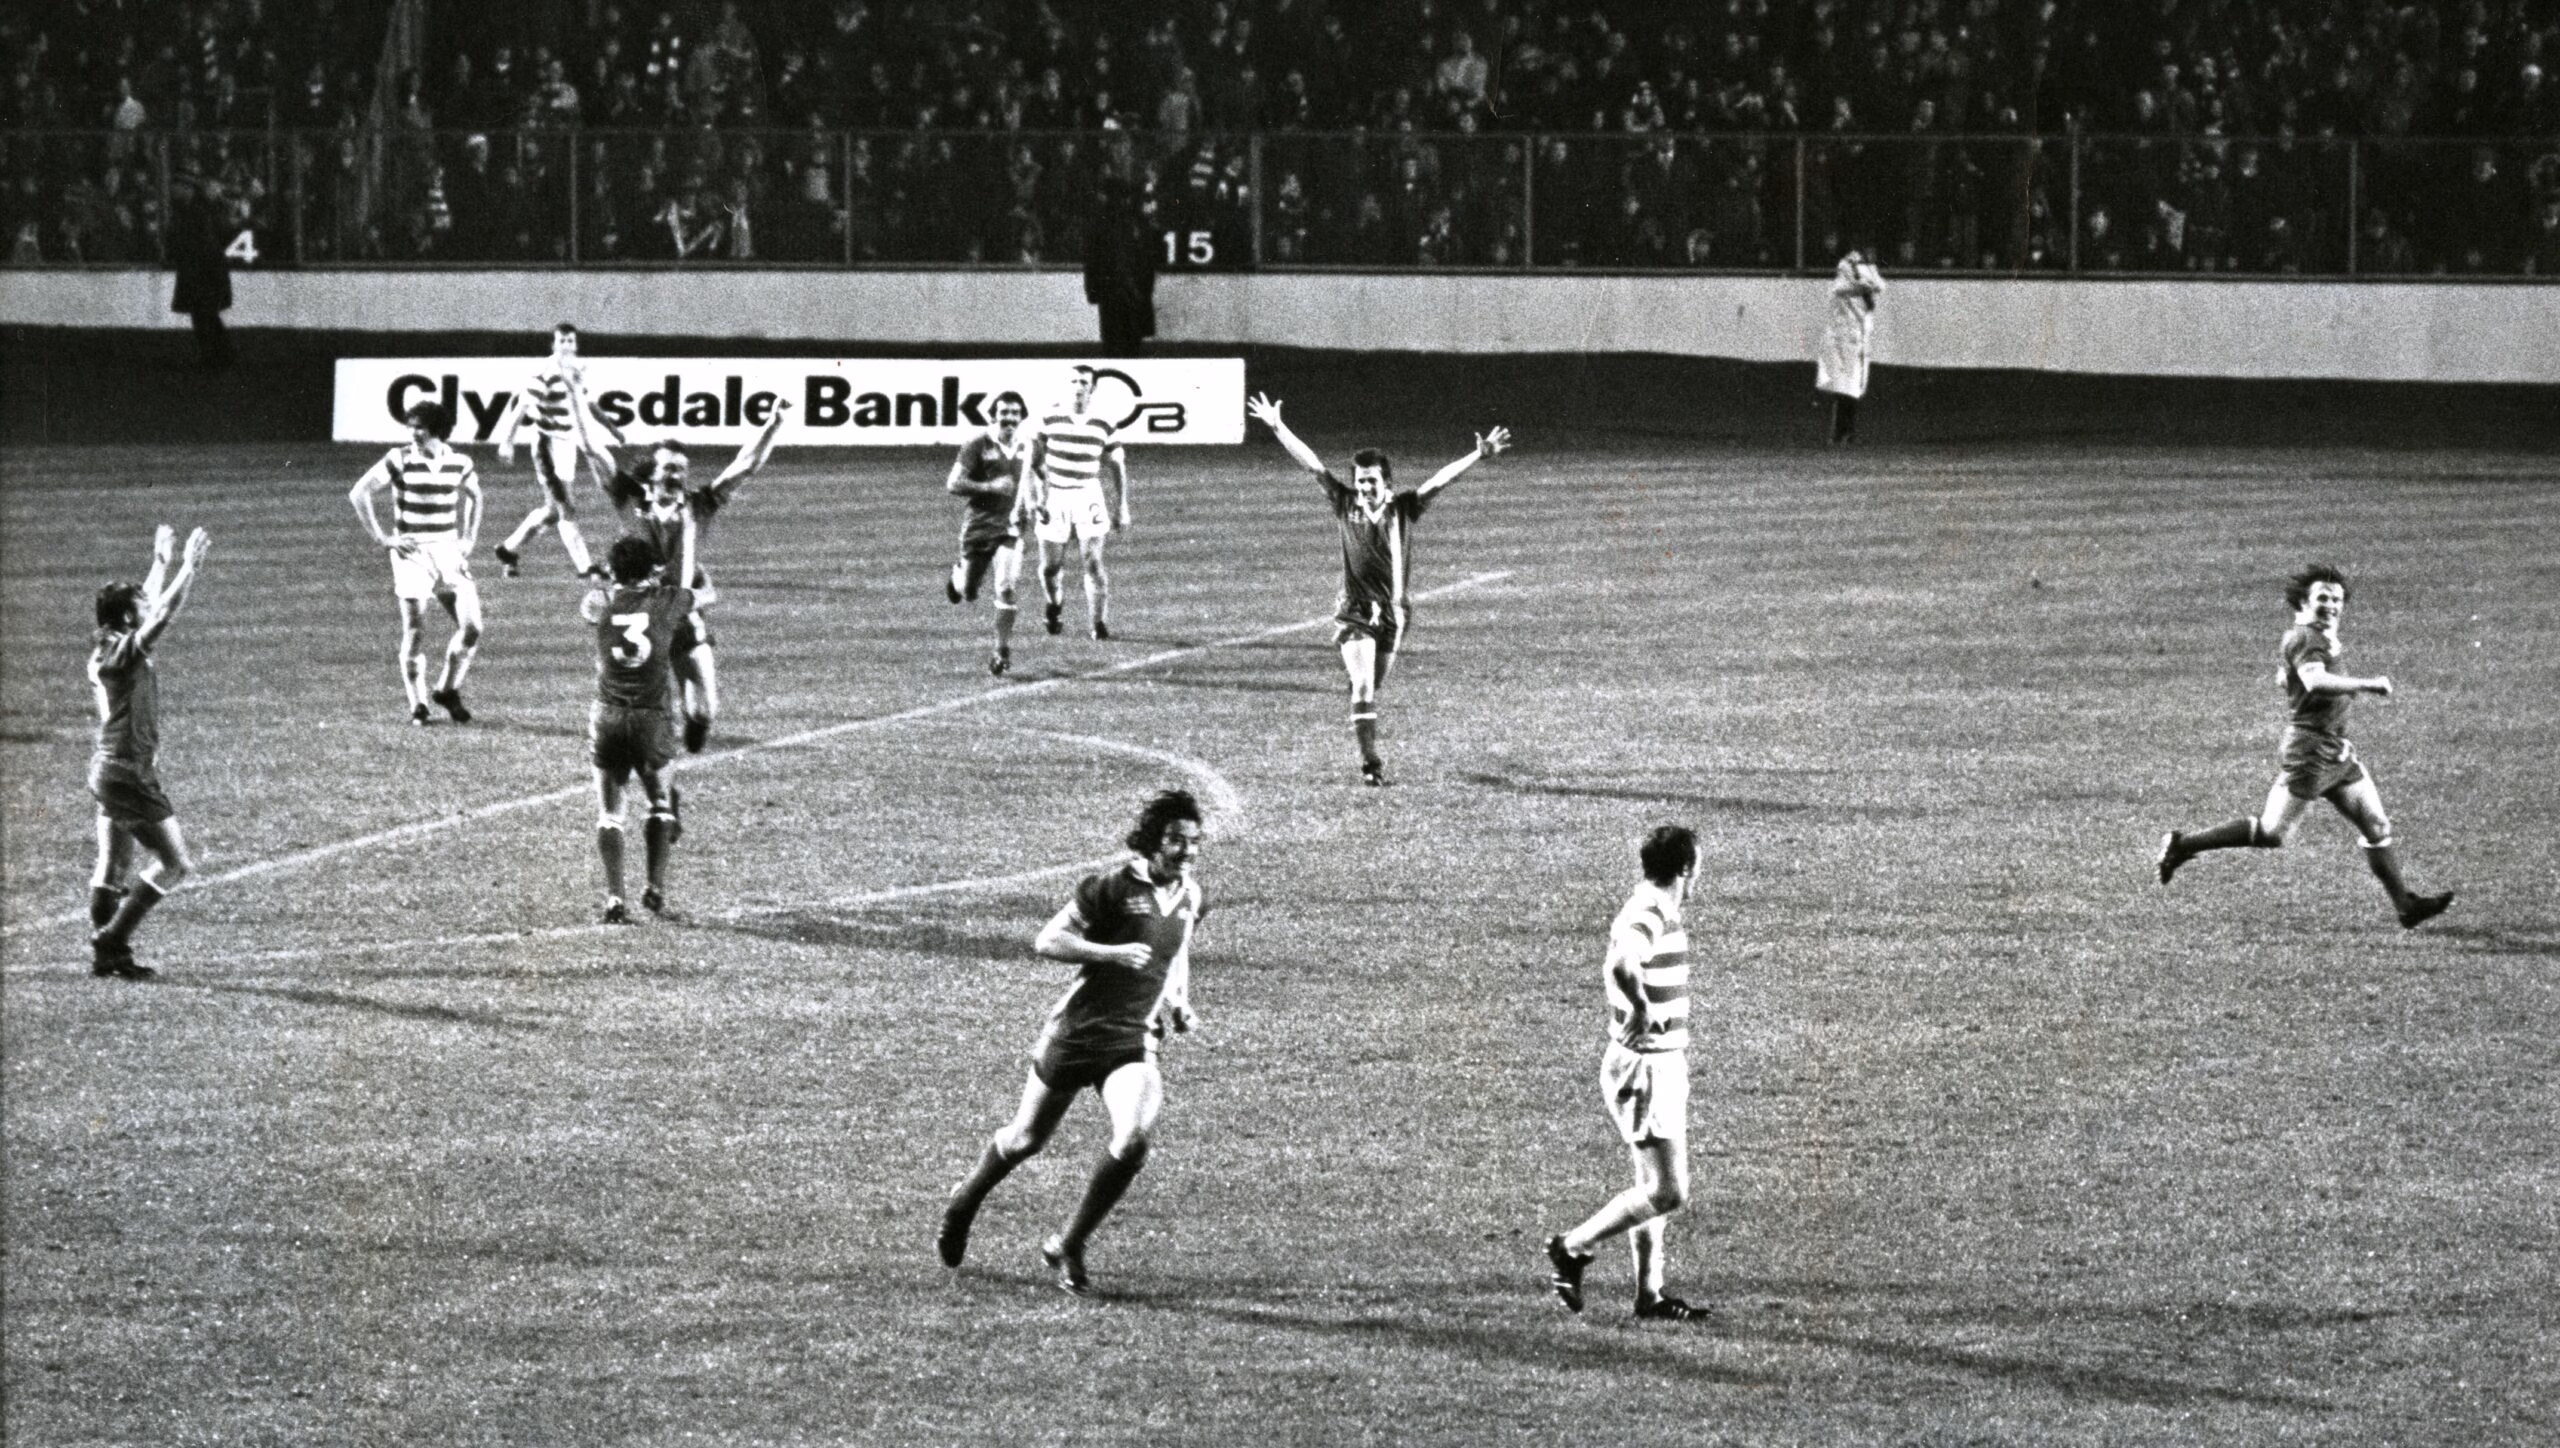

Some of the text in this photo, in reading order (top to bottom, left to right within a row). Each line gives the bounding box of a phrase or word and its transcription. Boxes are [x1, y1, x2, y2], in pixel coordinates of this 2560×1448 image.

[225, 229, 259, 264] 4
[1163, 231, 1214, 265] 15
[387, 374, 988, 441] Clysdale Bank
[611, 612, 652, 668] 3
